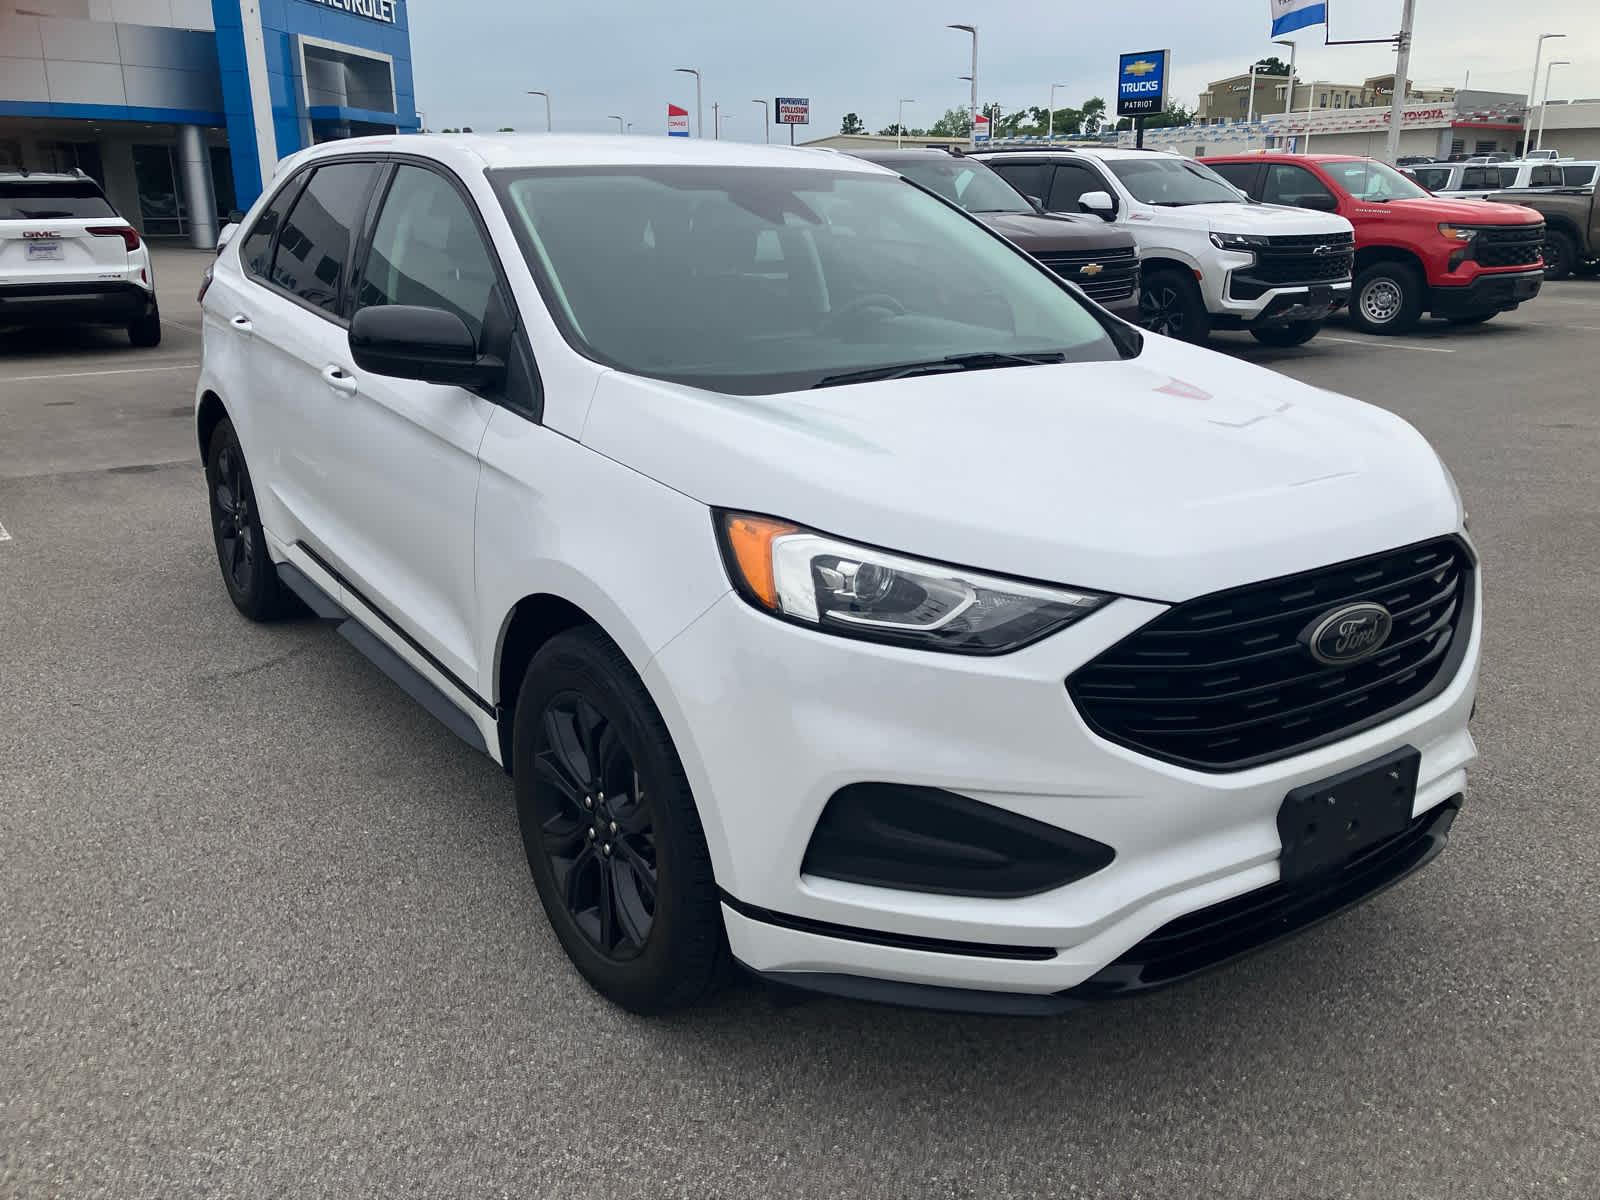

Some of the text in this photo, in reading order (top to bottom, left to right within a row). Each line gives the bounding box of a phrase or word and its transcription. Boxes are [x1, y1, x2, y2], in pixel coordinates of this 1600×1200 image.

[1121, 80, 1159, 93] TRUCKS
[1124, 100, 1153, 109] PATRIOT
[780, 105, 808, 114] COLLISION
[784, 114, 805, 122] CENTER
[1403, 109, 1444, 121] TOYOTA
[22, 230, 61, 238] GMC
[1336, 617, 1378, 654] Ford
